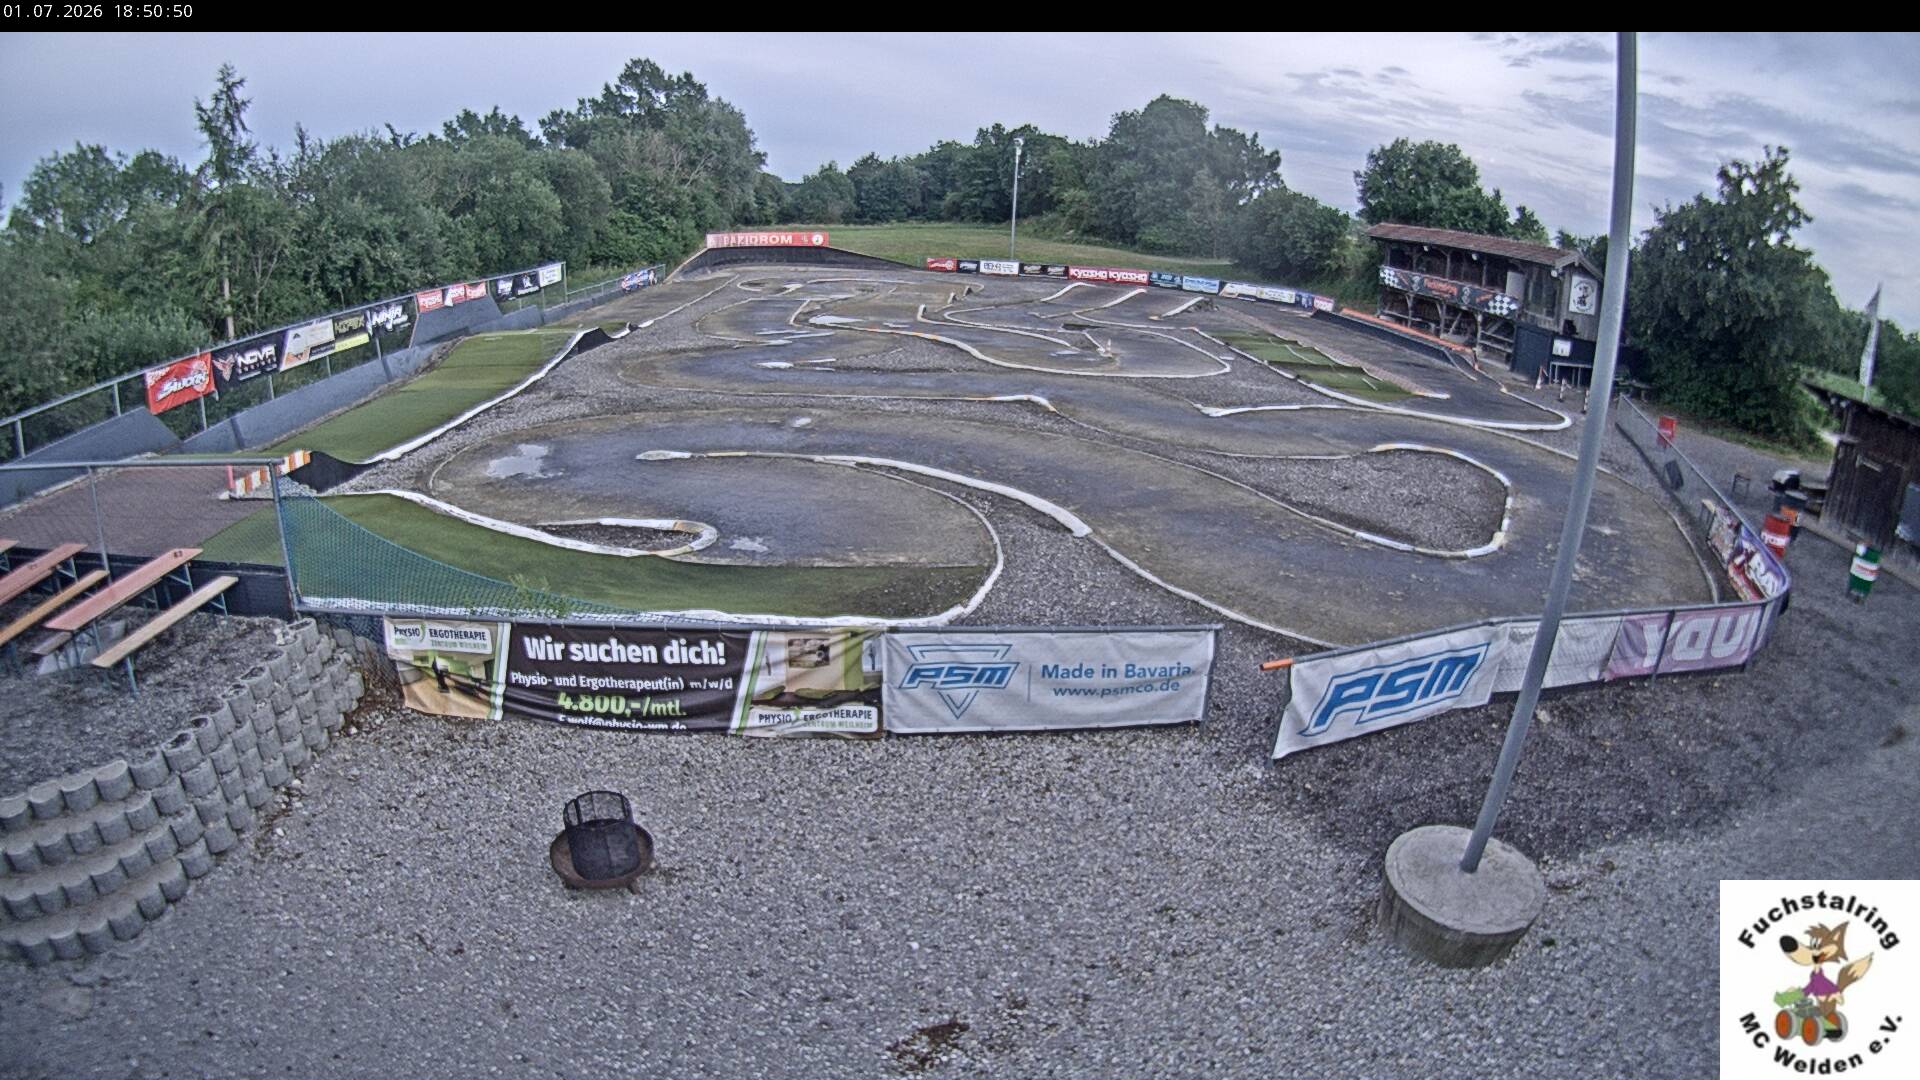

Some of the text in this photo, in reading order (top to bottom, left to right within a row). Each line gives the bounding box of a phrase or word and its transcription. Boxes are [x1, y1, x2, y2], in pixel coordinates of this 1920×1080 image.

[428, 628, 487, 640] ERGOTHERAPIE
[523, 636, 726, 665] Wir suchen dich!
[904, 664, 1014, 687] PSM
[1041, 662, 1191, 679] Made in Bavaria
[511, 671, 733, 692] Physio- und Ergotherapeut(in) m/w/d
[1053, 680, 1181, 697] www.psmco.de
[1312, 650, 1483, 731] PSM
[758, 709, 872, 723] PHYSIO ERGOTHERAPIE
